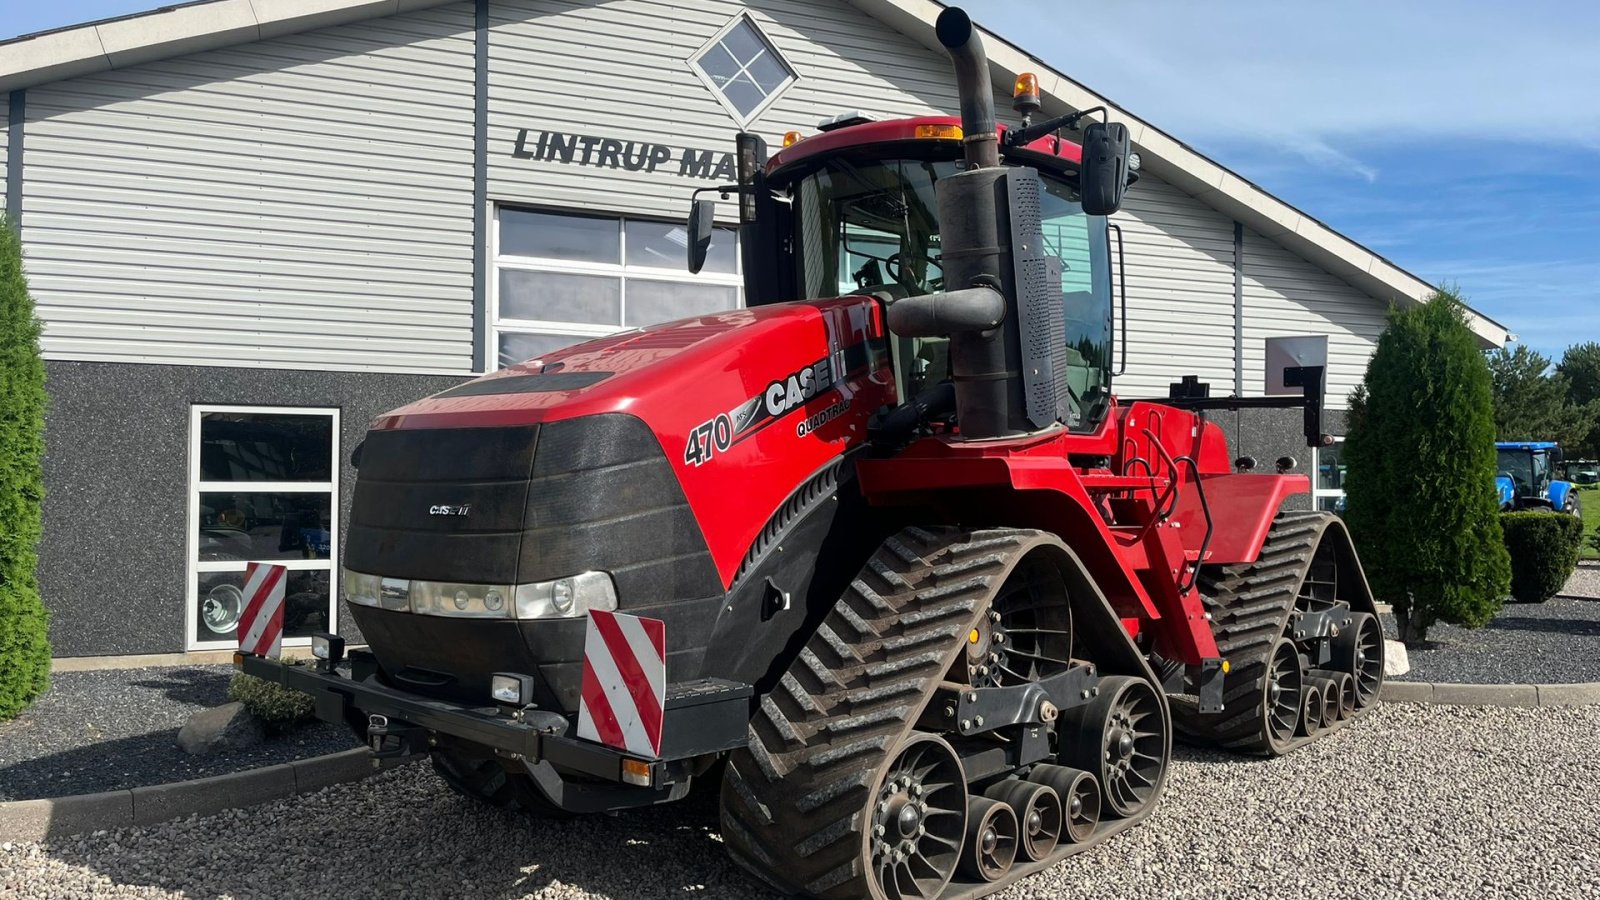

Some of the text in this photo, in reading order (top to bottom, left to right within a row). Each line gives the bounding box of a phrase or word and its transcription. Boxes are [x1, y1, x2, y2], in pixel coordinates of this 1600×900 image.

[512, 128, 738, 181] LINTRUP MA
[765, 359, 830, 416] CASE
[684, 412, 731, 467] 470
[797, 403, 850, 438] QUADTRAC
